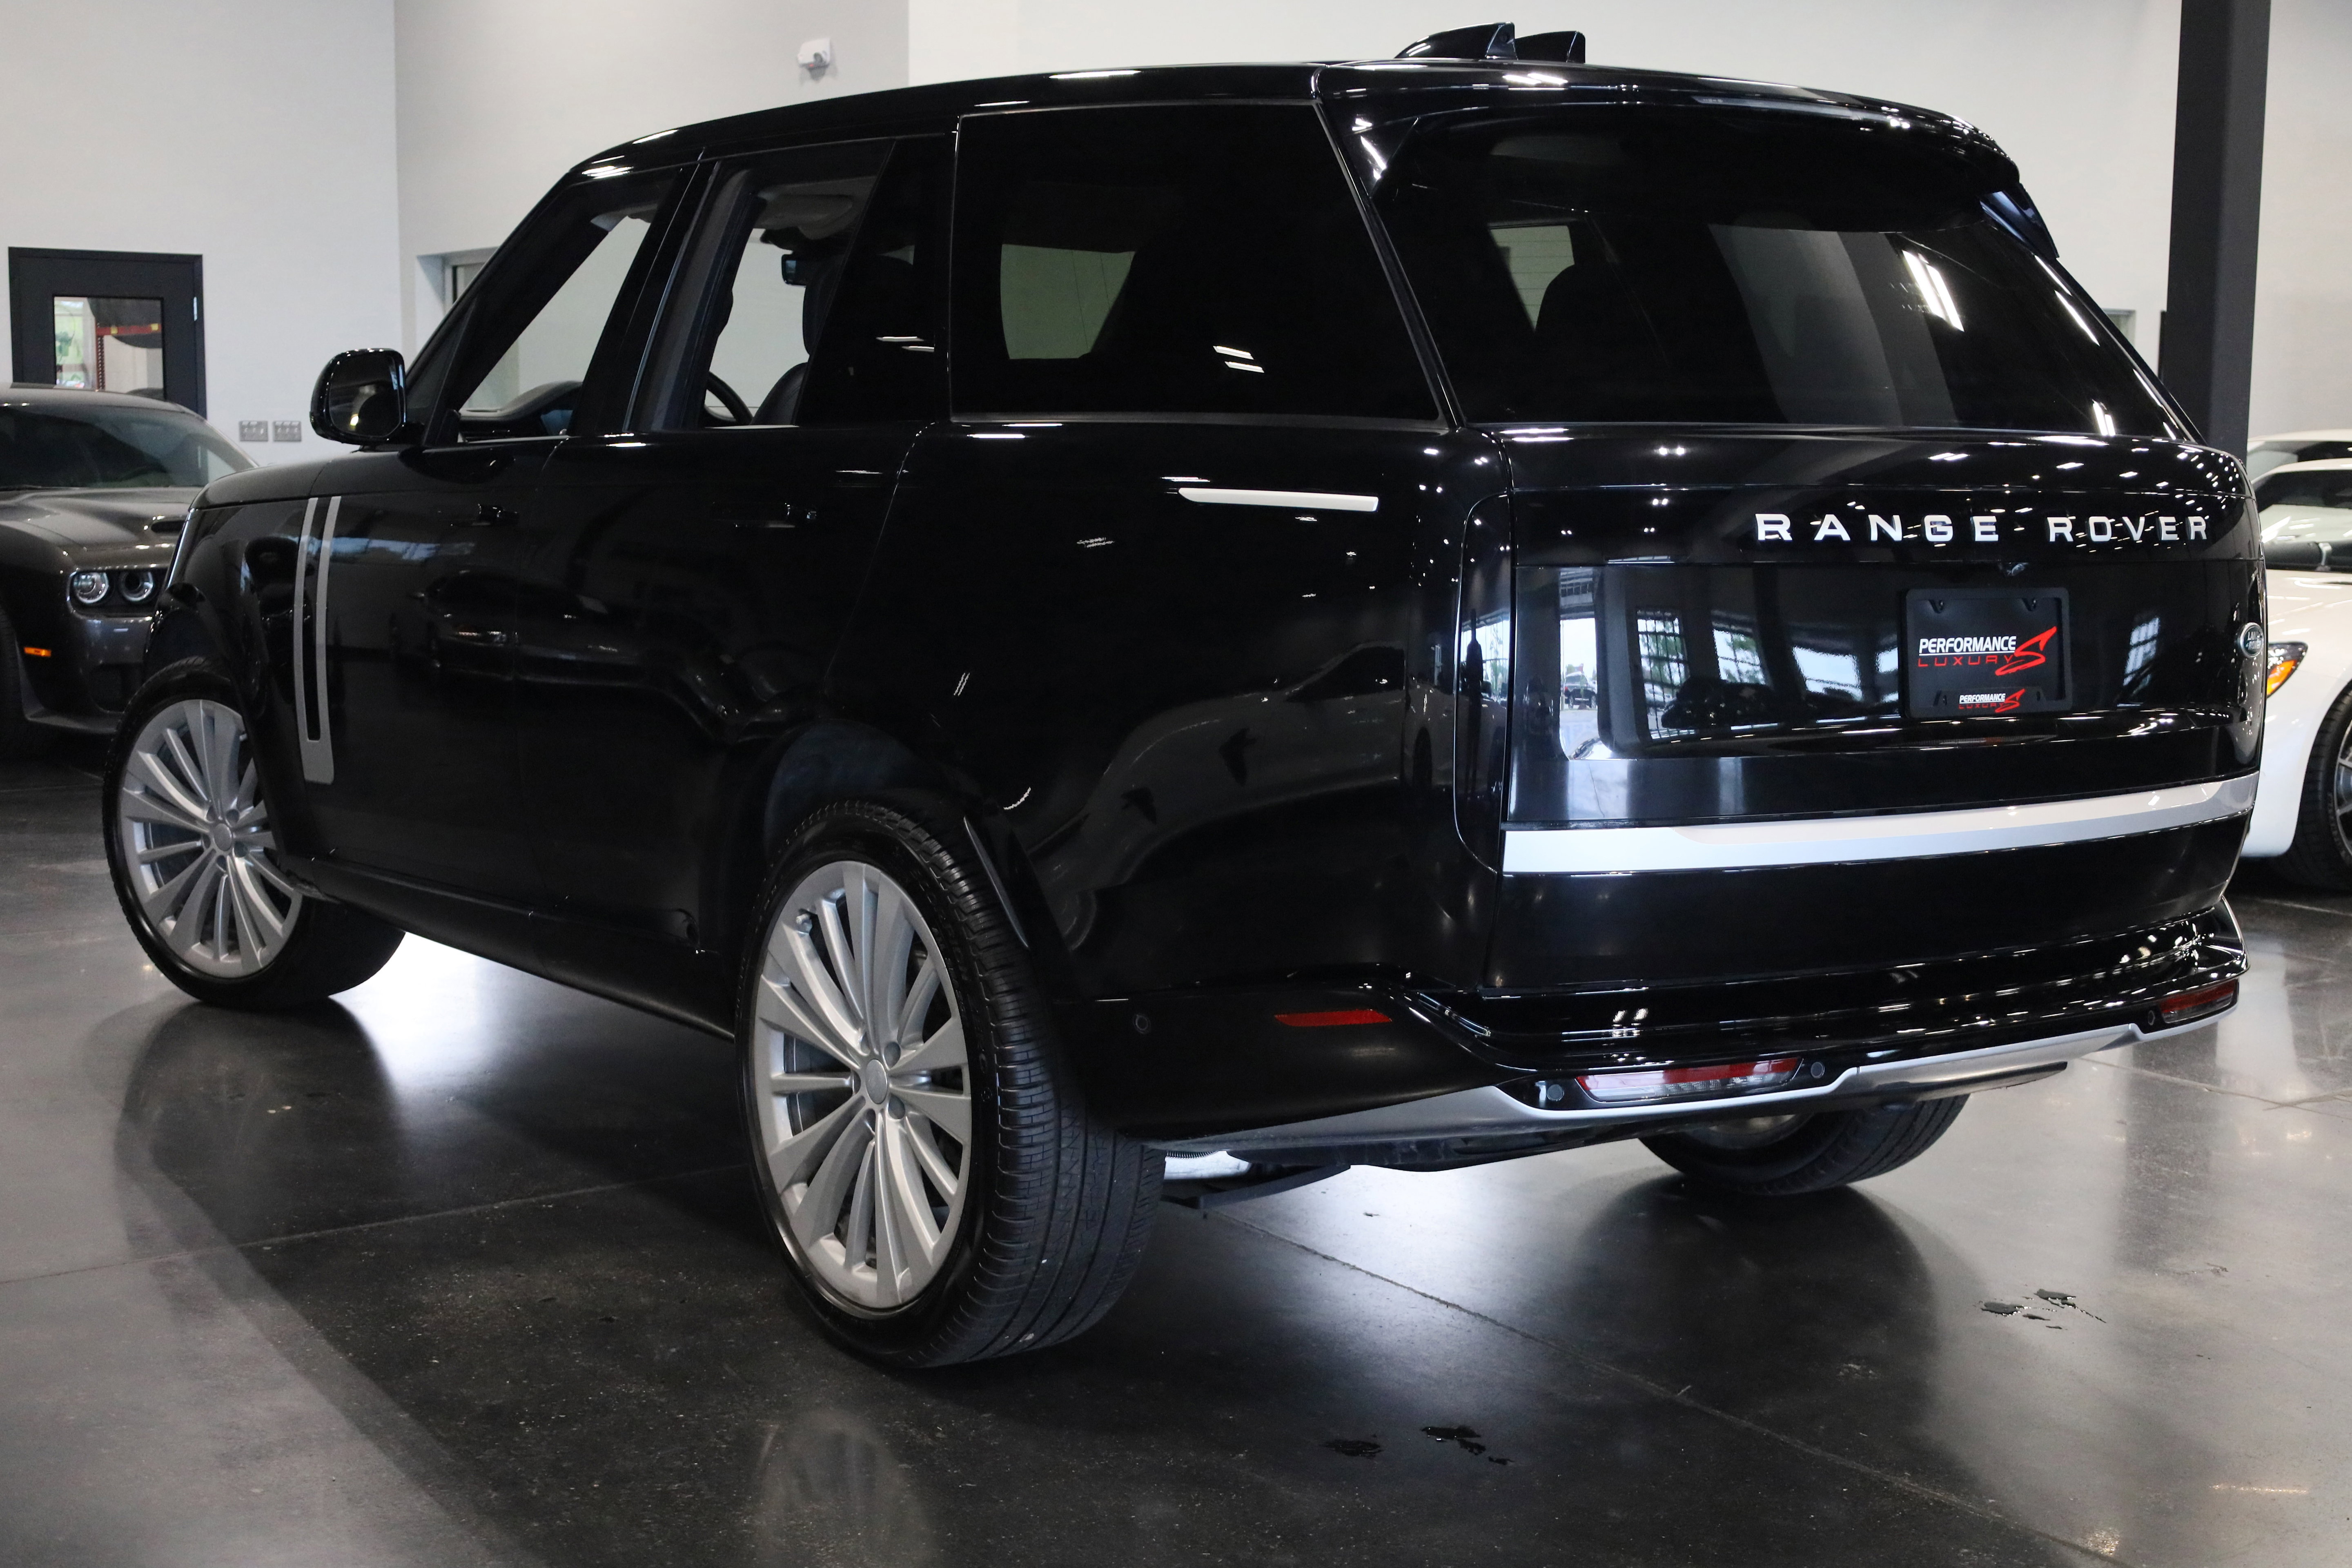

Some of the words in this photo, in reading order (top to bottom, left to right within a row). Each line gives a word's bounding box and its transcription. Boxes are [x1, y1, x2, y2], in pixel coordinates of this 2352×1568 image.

[1755, 513, 1999, 541] RANGE
[2046, 516, 2207, 542] ROVER
[1919, 636, 2016, 653] PERFORMANCE
[1918, 655, 2014, 667] LUXURY
[1960, 693, 2006, 702] PERFORMANCE
